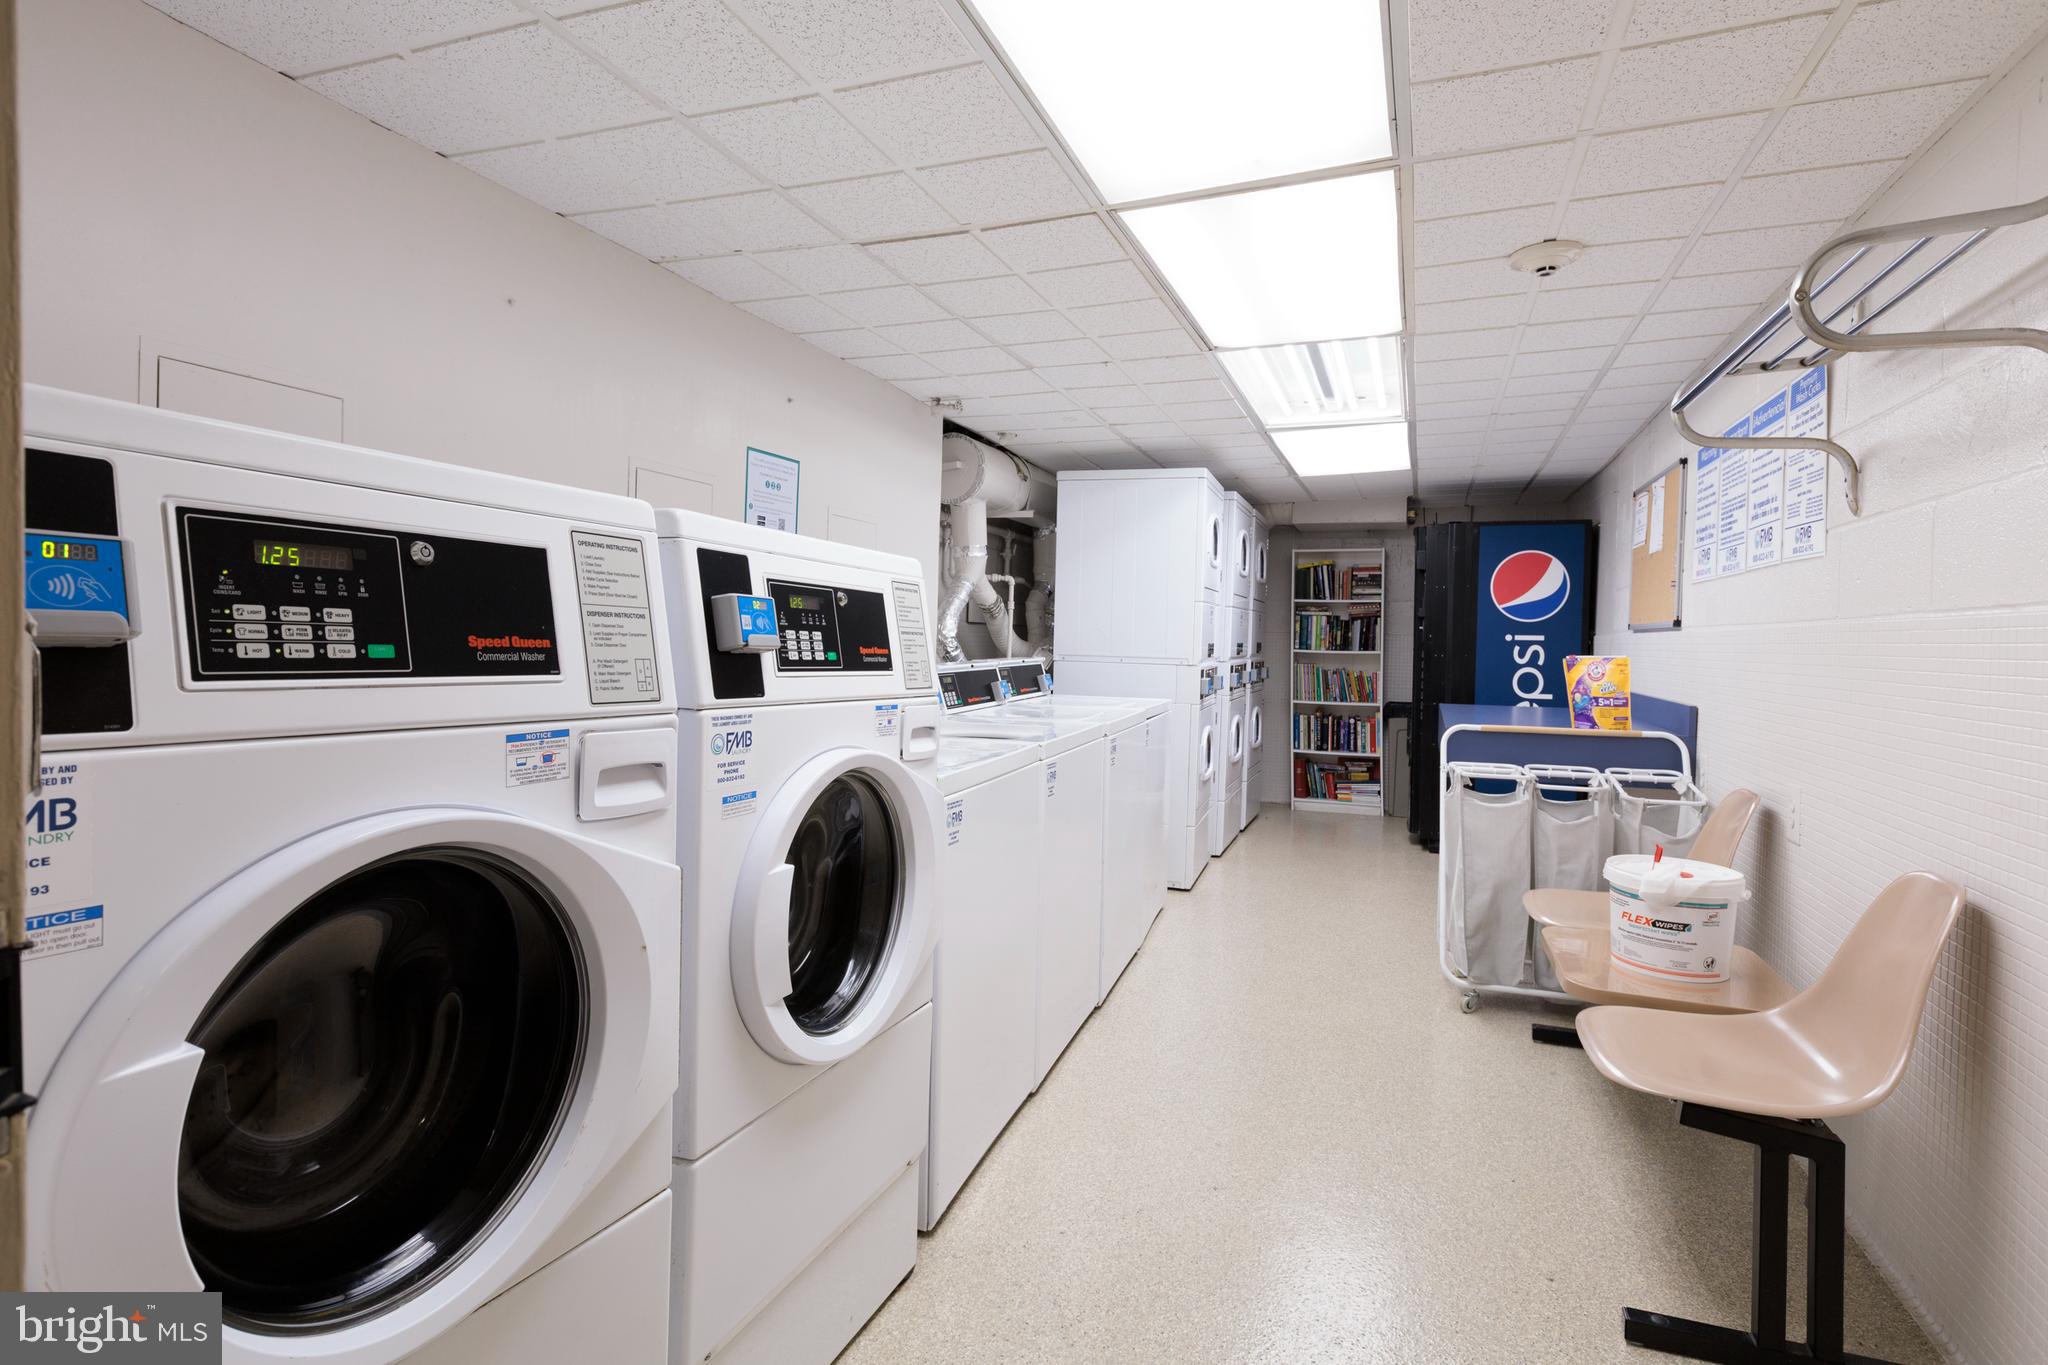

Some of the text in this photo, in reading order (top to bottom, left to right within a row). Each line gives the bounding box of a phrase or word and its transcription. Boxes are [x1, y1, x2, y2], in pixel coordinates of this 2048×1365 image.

[577, 540, 638, 553] OPERATING INSTRUCTIONS
[262, 545, 300, 566] 1.25
[586, 610, 613, 618] DISPENSER
[468, 635, 552, 650] Speed Queen
[477, 651, 546, 661] Commercial Washer
[1505, 634, 1553, 708] psi
[526, 732, 552, 740] NOTICE
[726, 730, 752, 755] FMB
[42, 765, 77, 774] BY AND
[60, 776, 73, 785] BY
[727, 792, 752, 803] NOTICE
[26, 797, 77, 833] MB
[28, 831, 74, 846] NDRY
[26, 909, 87, 929] TICE
[1621, 911, 1684, 931] FLEX WIPES
[49, 935, 69, 943] open
[26, 947, 44, 955] door
[73, 939, 87, 947] pull
